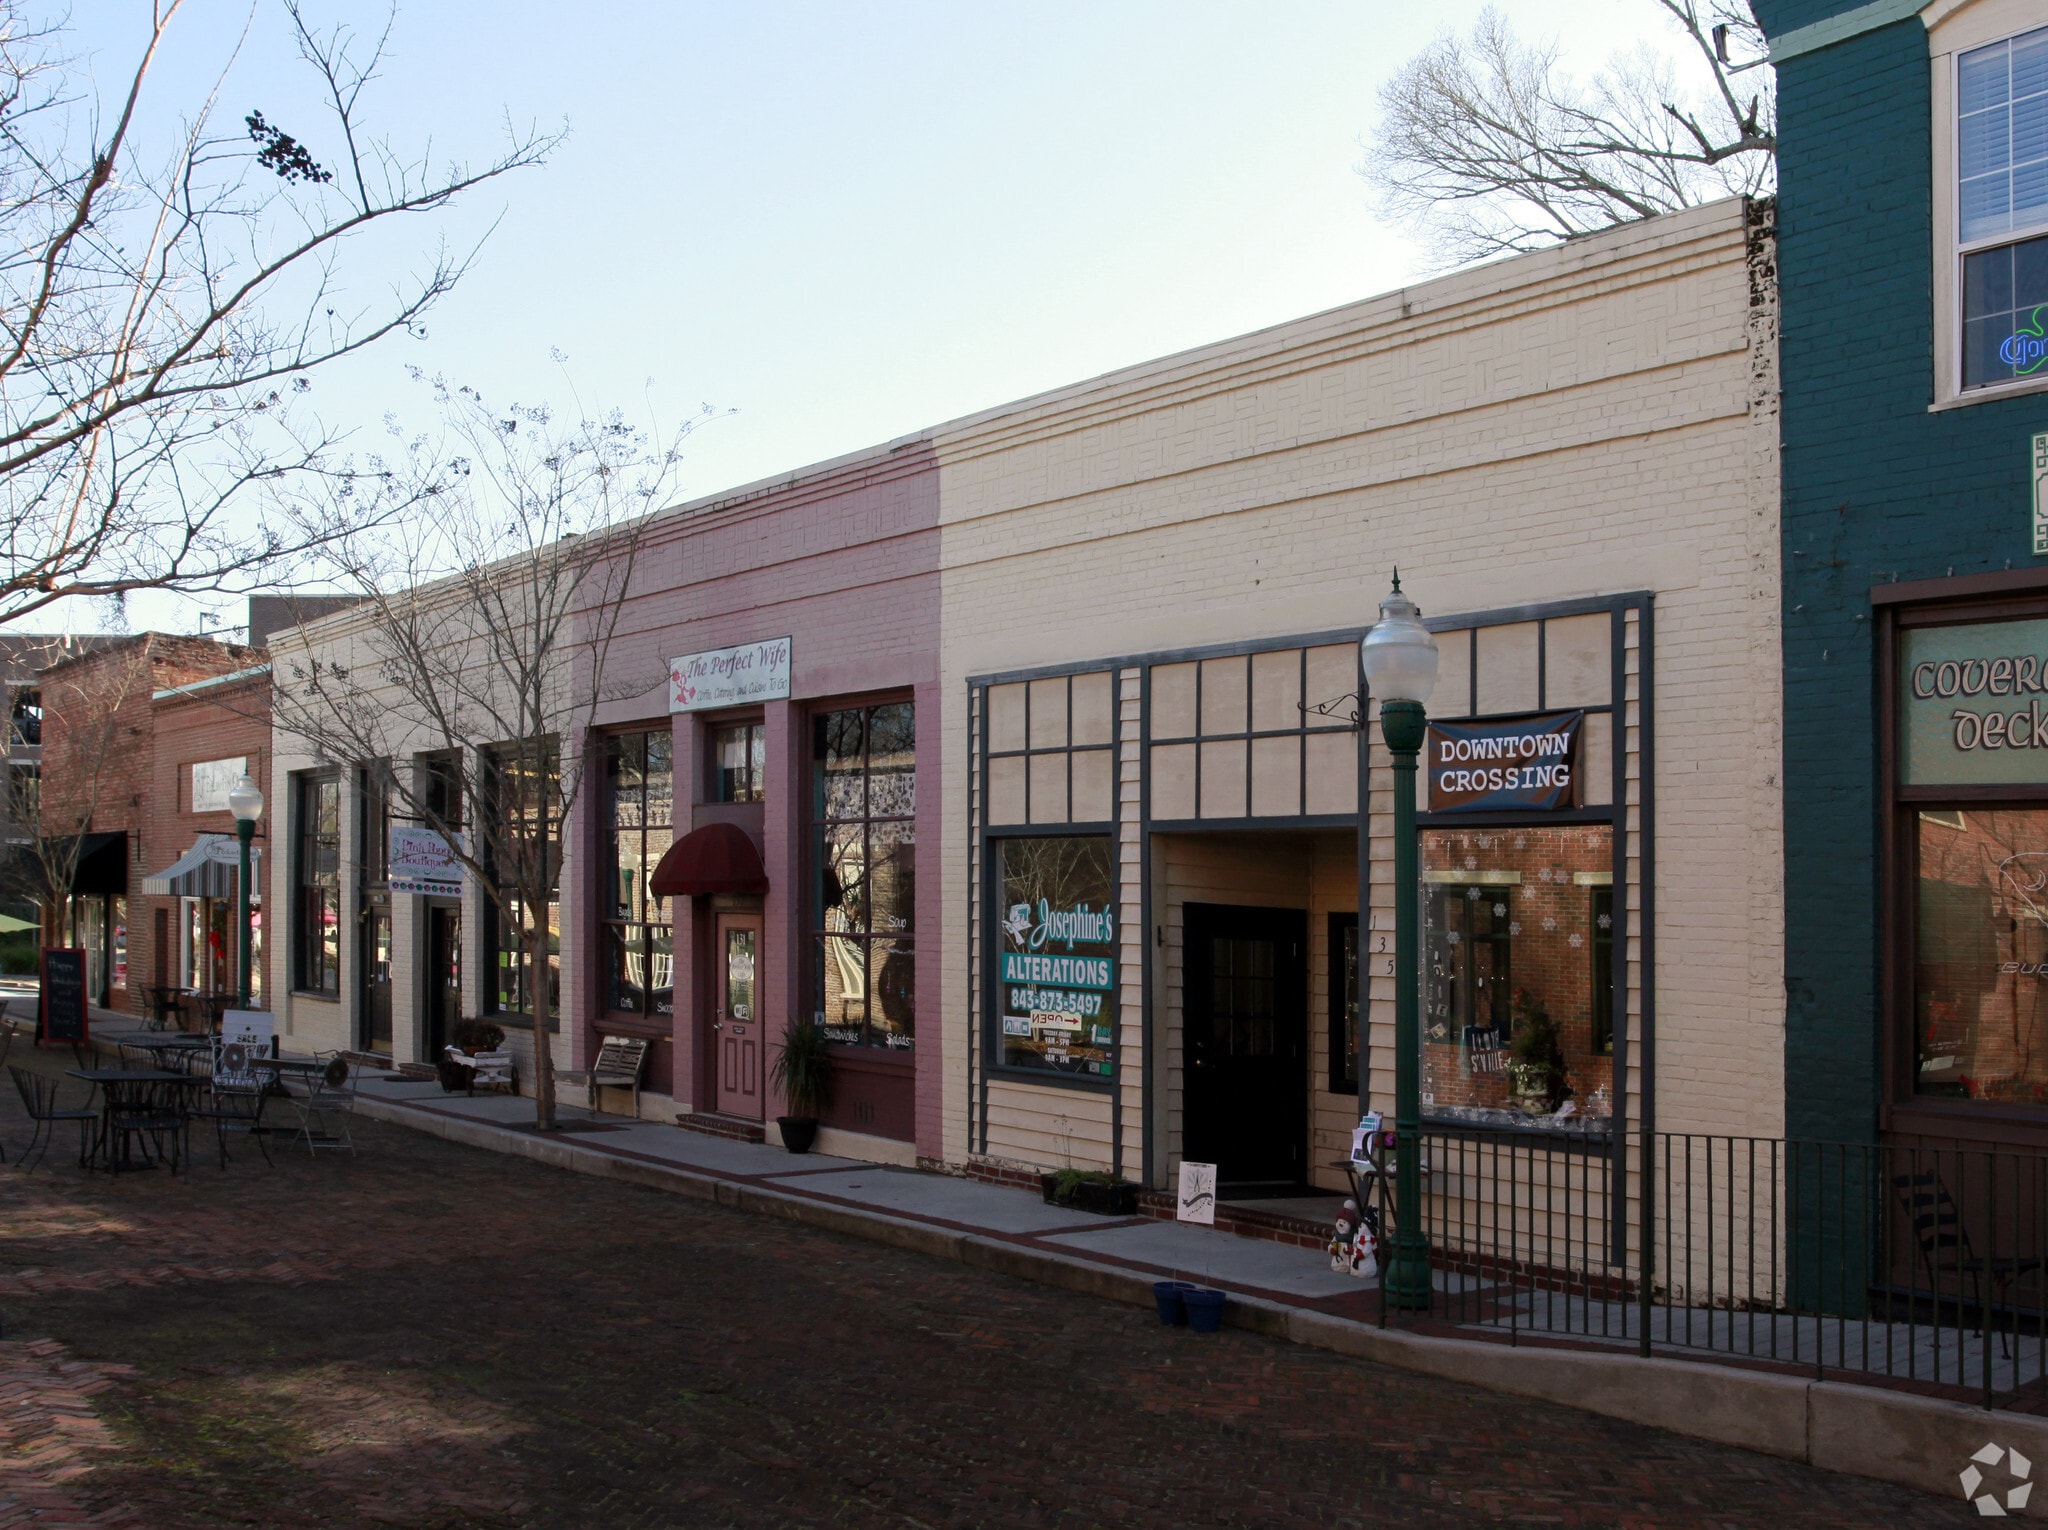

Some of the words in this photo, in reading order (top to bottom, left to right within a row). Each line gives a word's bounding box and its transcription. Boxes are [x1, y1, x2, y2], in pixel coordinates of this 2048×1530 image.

[687, 656, 708, 679] The
[711, 648, 754, 680] Perfect
[758, 641, 788, 673] Wife
[737, 683, 748, 697] and
[770, 677, 778, 692] To
[1440, 732, 1571, 763] DOWNTOWN
[1440, 763, 1571, 793] CROSSING
[888, 915, 908, 931] Soup
[1030, 897, 1113, 949] Josephine's
[736, 932, 747, 946] 131
[1006, 955, 1109, 987] ALTERATIONS
[1010, 988, 1102, 1015] 843-873-5497
[237, 1034, 257, 1044] SALE
[886, 1032, 910, 1048] Salads
